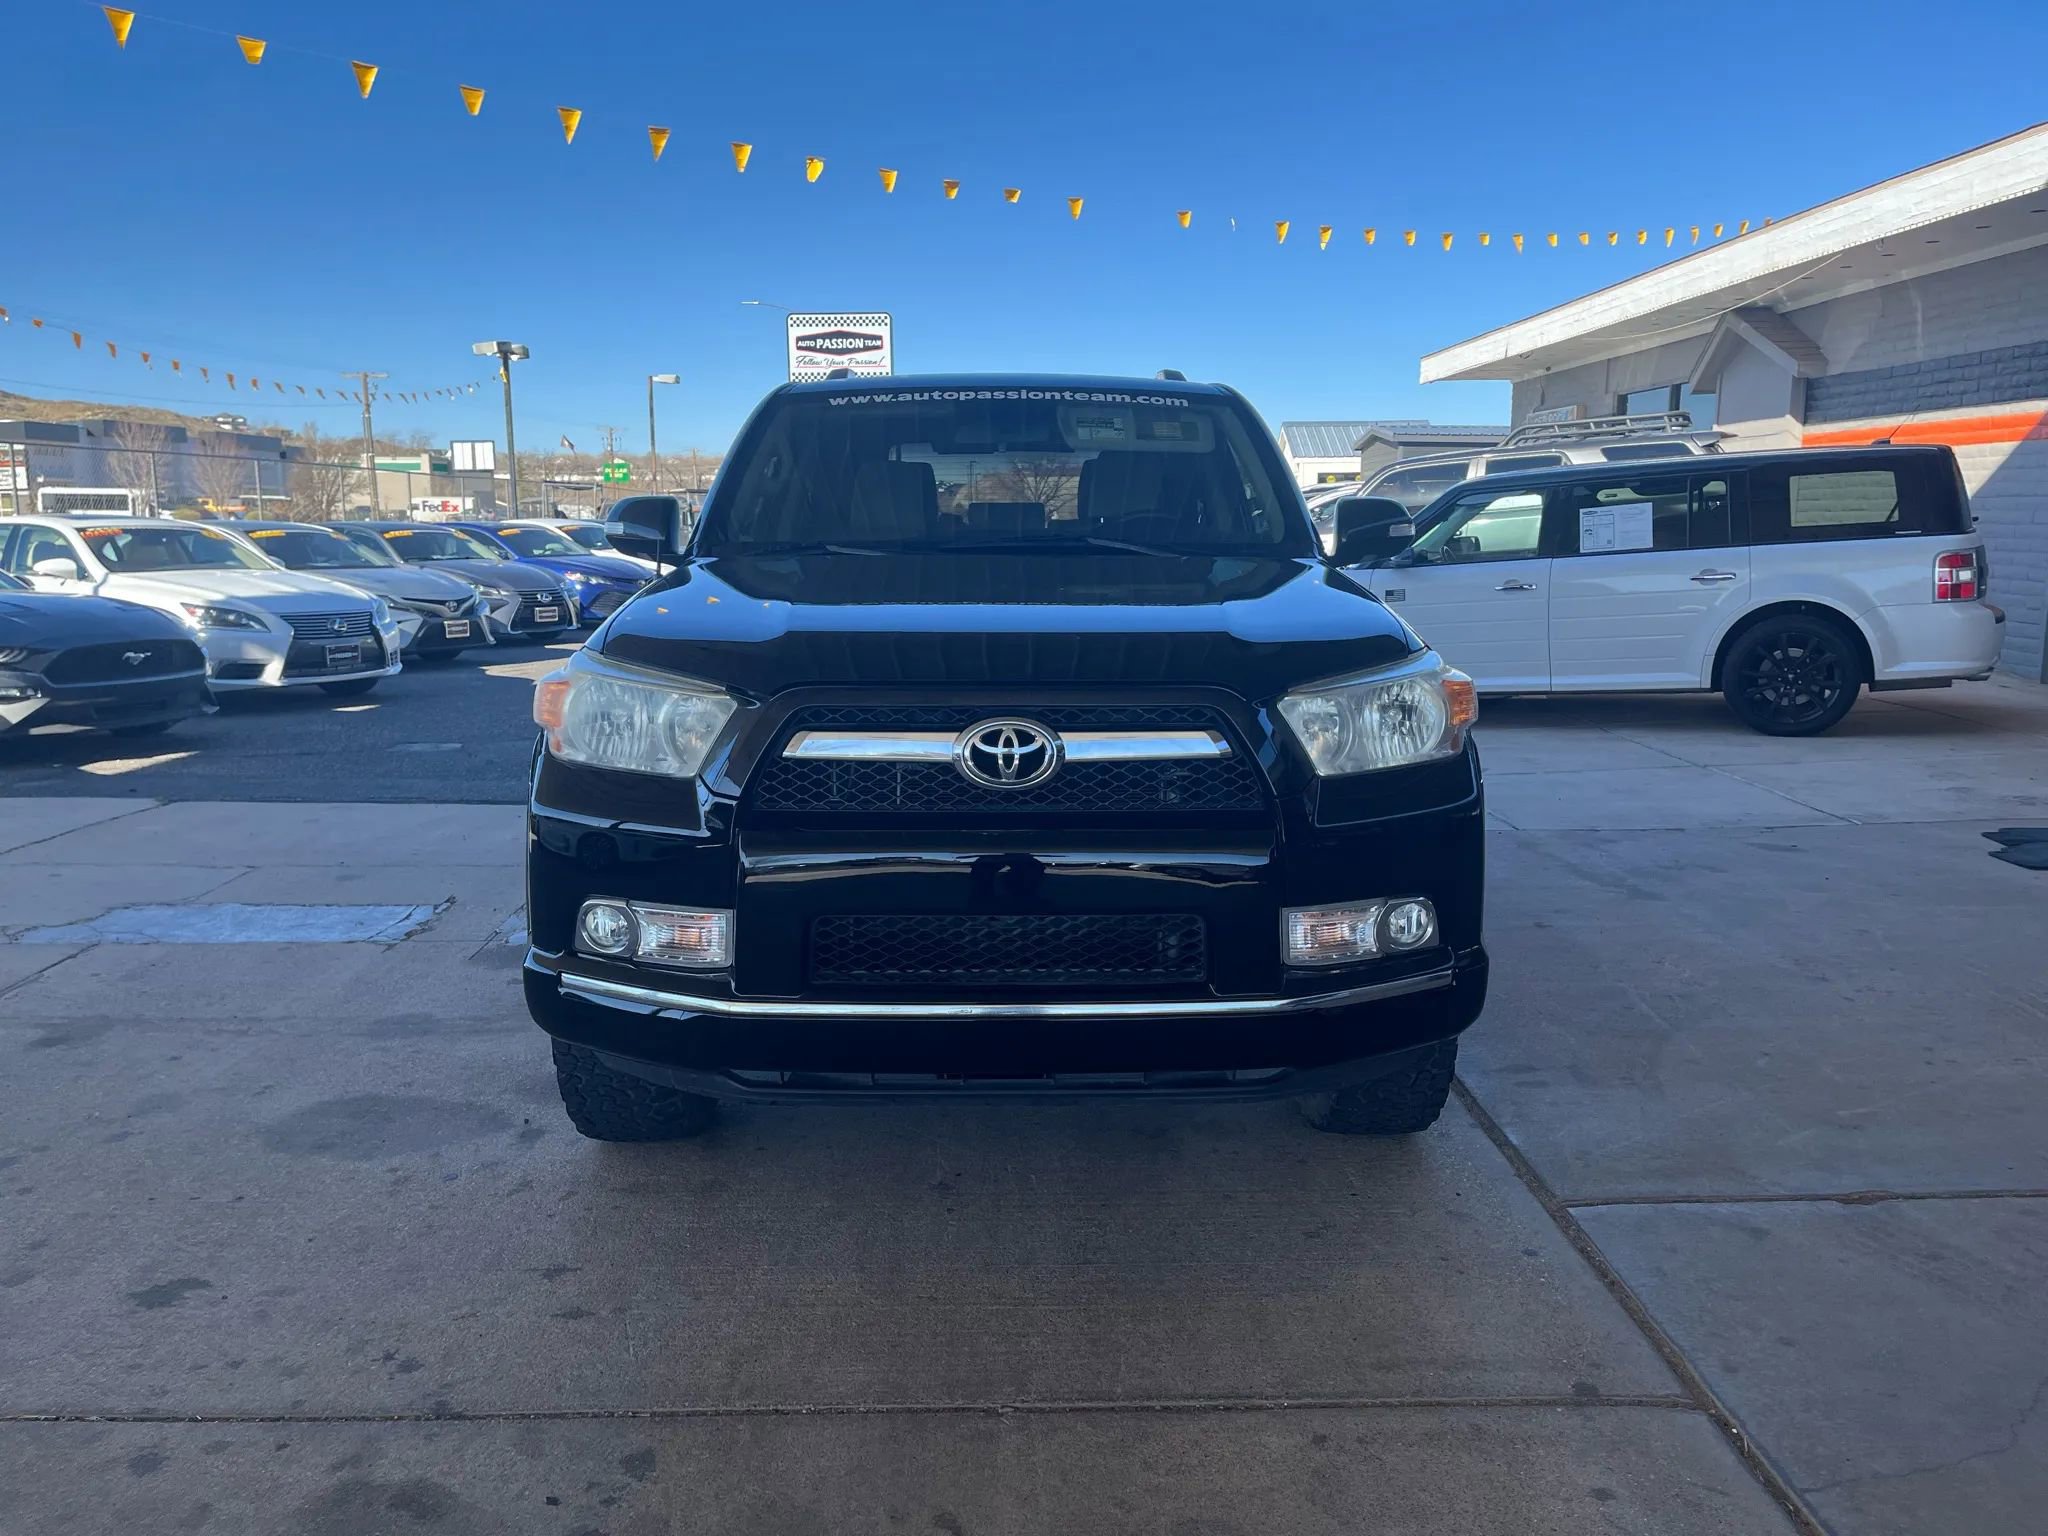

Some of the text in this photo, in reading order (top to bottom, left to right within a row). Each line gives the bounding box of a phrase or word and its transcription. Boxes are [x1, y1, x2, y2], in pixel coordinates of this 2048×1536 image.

[816, 338, 864, 349] PASSION
[795, 355, 885, 369] Follow Your Passion!
[829, 390, 1189, 407] www.autopassionteam.com
[422, 500, 459, 512] FedEx
